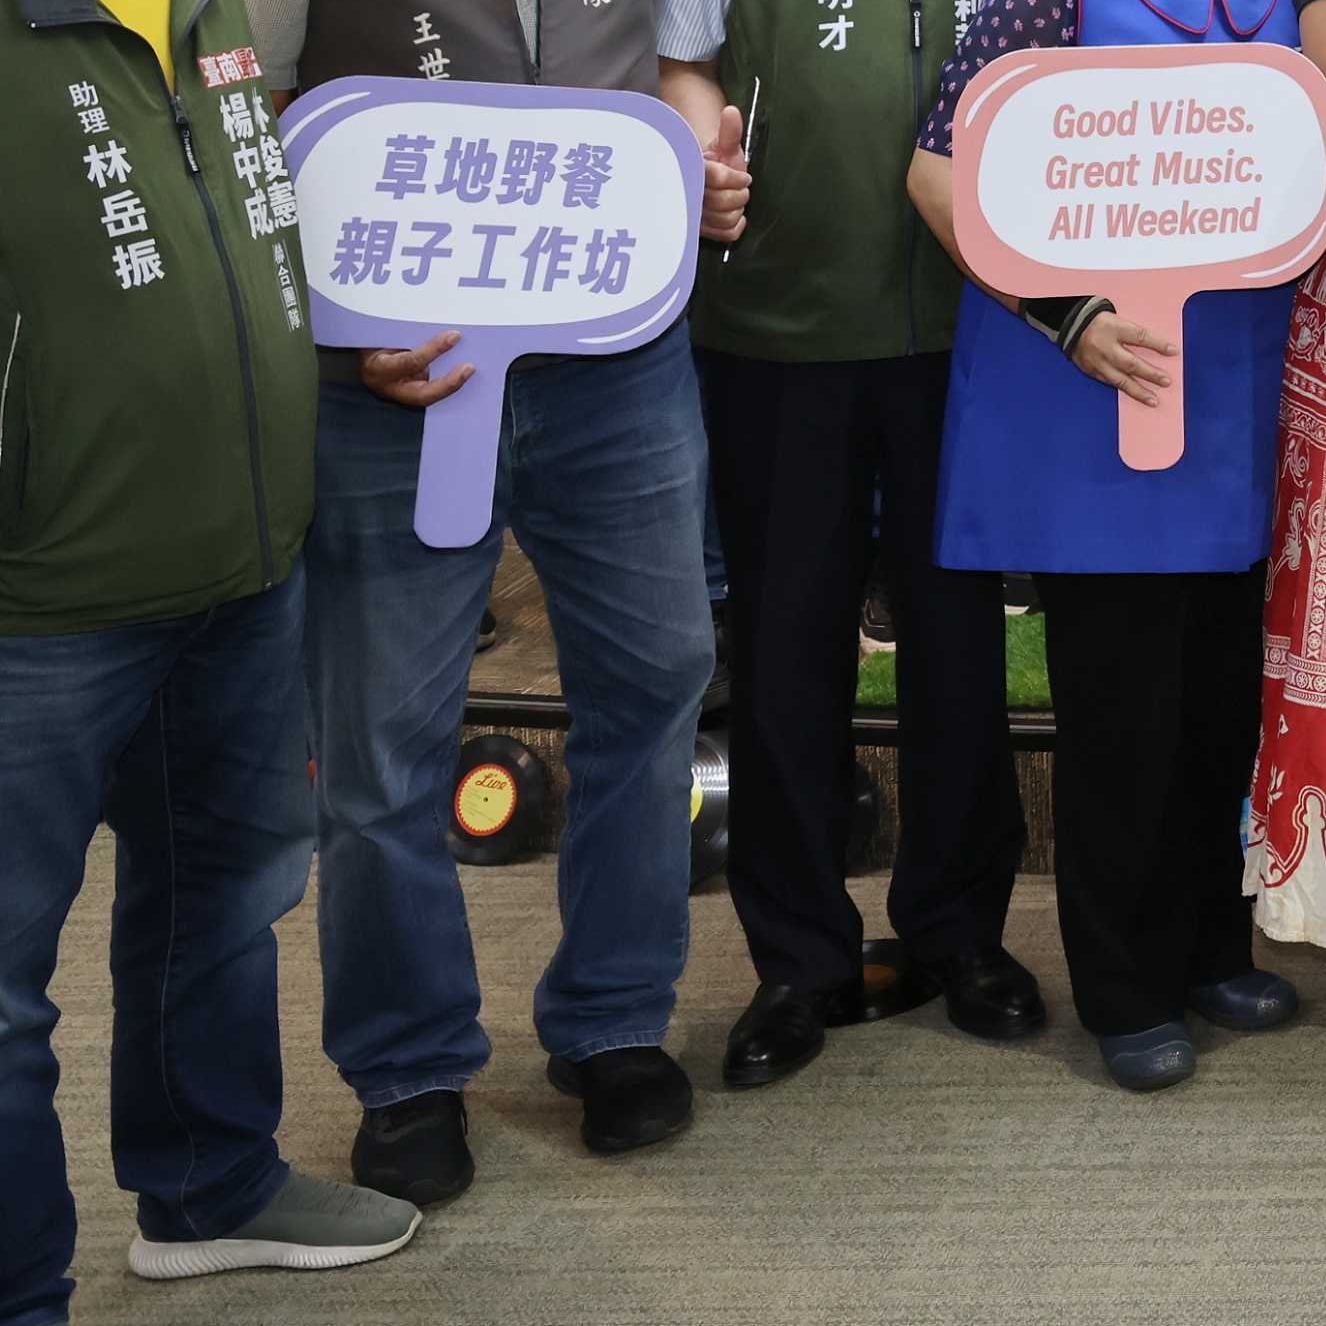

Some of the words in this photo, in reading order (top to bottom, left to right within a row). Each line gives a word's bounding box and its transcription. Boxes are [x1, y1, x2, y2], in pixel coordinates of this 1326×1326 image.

[67, 82, 111, 134] 助理
[1052, 100, 1138, 139] Good
[1149, 99, 1256, 136] Vibes.
[219, 91, 275, 240] 楊中成
[373, 134, 614, 211] 草地野餐
[1045, 151, 1140, 190] Great
[1151, 149, 1263, 187] Music.
[82, 141, 166, 291] 林岳振
[1048, 205, 1095, 241] All
[1104, 197, 1262, 239] Weekend
[329, 216, 637, 297] 親子工作坊
[474, 772, 508, 791] Live
